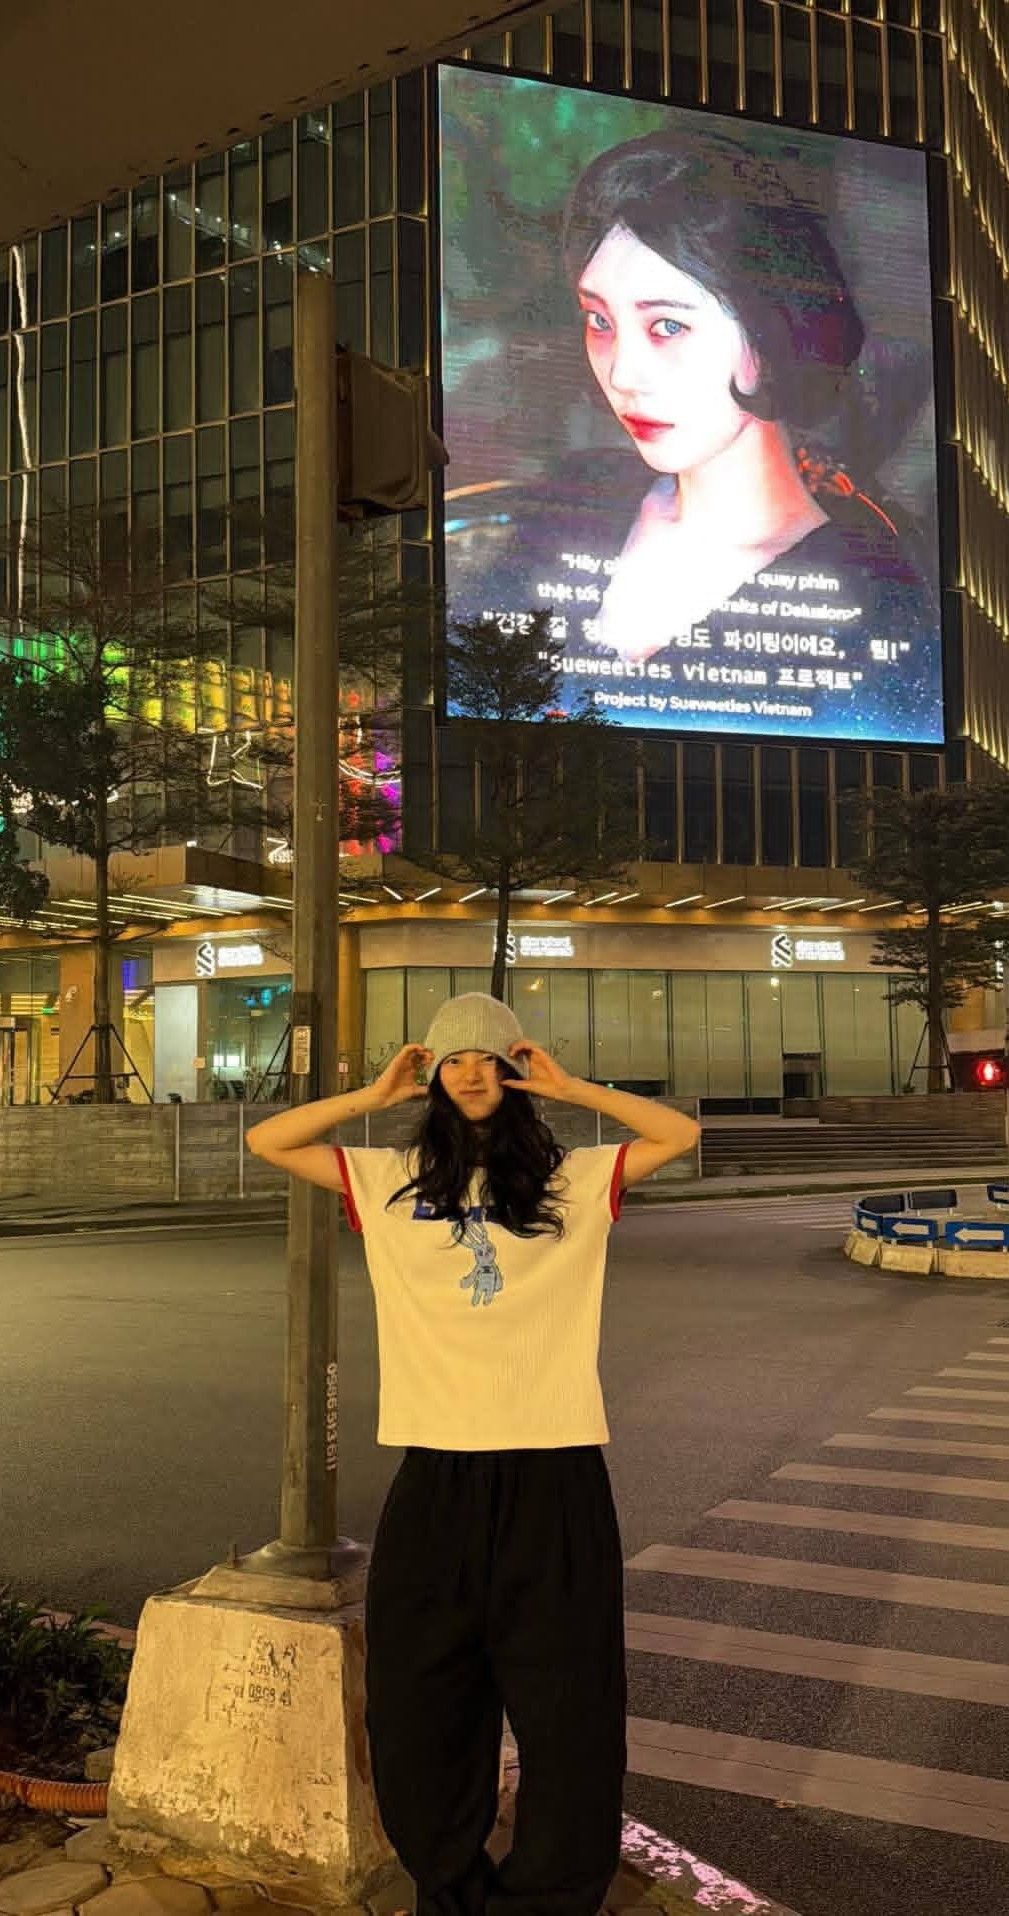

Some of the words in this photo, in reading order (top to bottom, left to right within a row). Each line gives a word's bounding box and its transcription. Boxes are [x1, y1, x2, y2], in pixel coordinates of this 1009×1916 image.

[757, 573, 798, 590] quay
[798, 572, 840, 592] phim
[761, 601, 779, 617] of
[682, 662, 768, 686] Vietnam
[594, 691, 647, 709] Project
[648, 694, 668, 713] by
[752, 701, 813, 718] Vietnam
